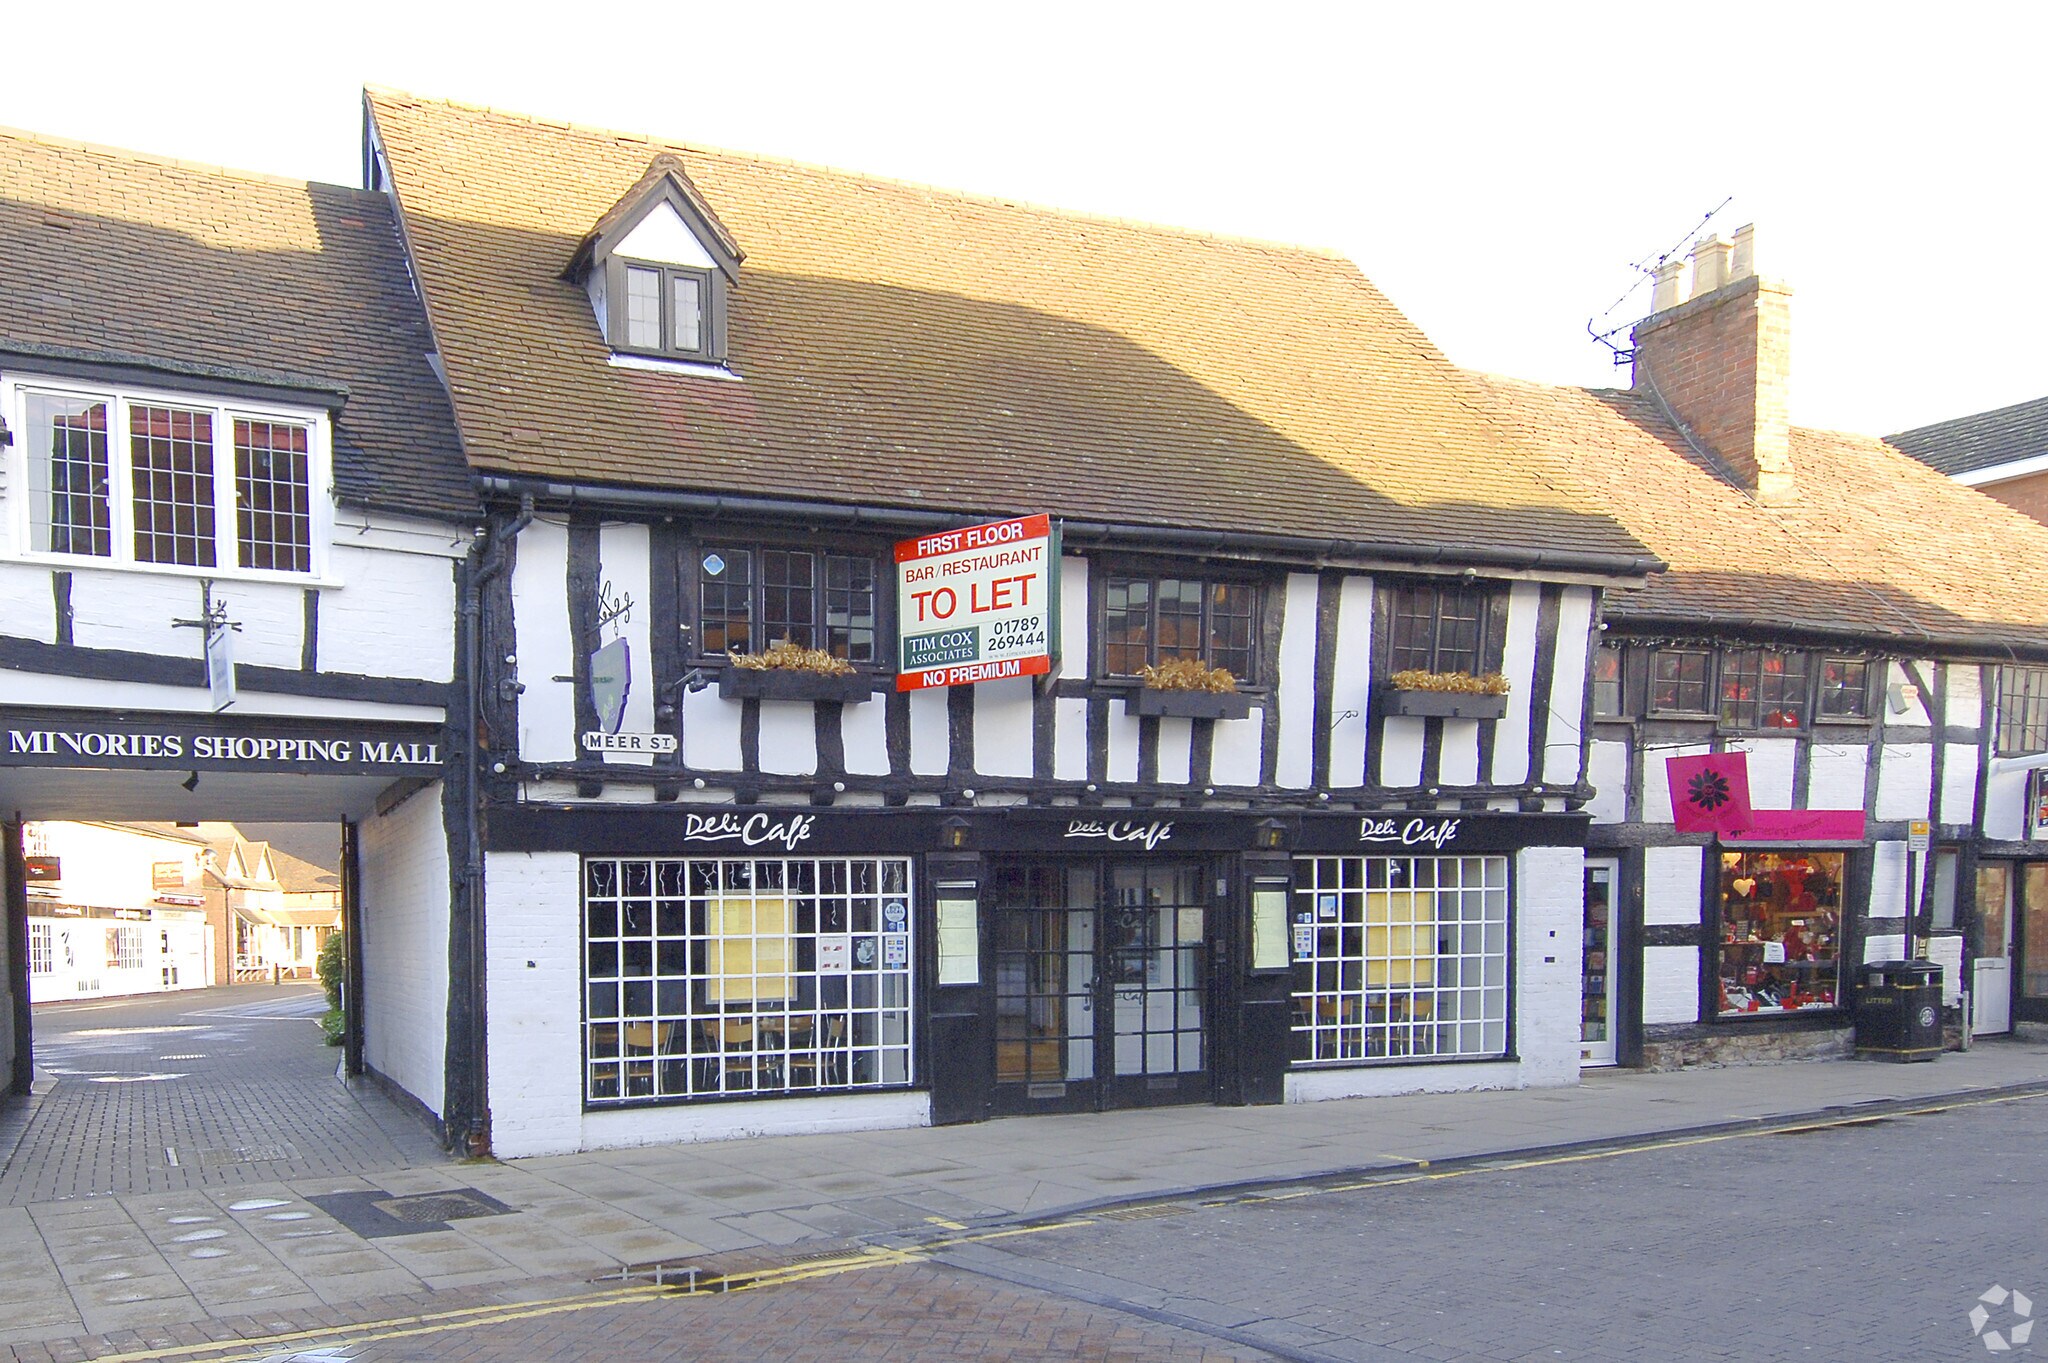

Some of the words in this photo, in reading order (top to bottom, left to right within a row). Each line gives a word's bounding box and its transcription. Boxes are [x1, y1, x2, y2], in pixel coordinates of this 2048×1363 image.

[917, 534, 962, 556] FIRST
[967, 522, 1023, 548] FLOOR
[905, 546, 1042, 583] BAR/RESTAURANT
[911, 587, 957, 622] TO
[971, 573, 1036, 613] LET
[994, 616, 1039, 635] 01789
[909, 637, 936, 653] TIM
[940, 631, 973, 647] COX
[988, 631, 1045, 651] 269444
[909, 647, 973, 665] ASSOCIATES
[923, 669, 946, 687] NO
[950, 660, 1020, 683] PREMIUM
[9, 730, 183, 758] MINORIES
[194, 736, 352, 762] SHOPPING
[360, 741, 443, 765] MALL
[590, 735, 641, 749] MEER
[650, 737, 671, 749] ST
[685, 813, 742, 838] Deli
[743, 813, 815, 850] Café
[1066, 820, 1105, 836] Deli
[1107, 820, 1174, 850] Café
[1360, 818, 1400, 840] Deli
[1402, 818, 1460, 849] Café
[1865, 997, 1893, 1005] LITTER
